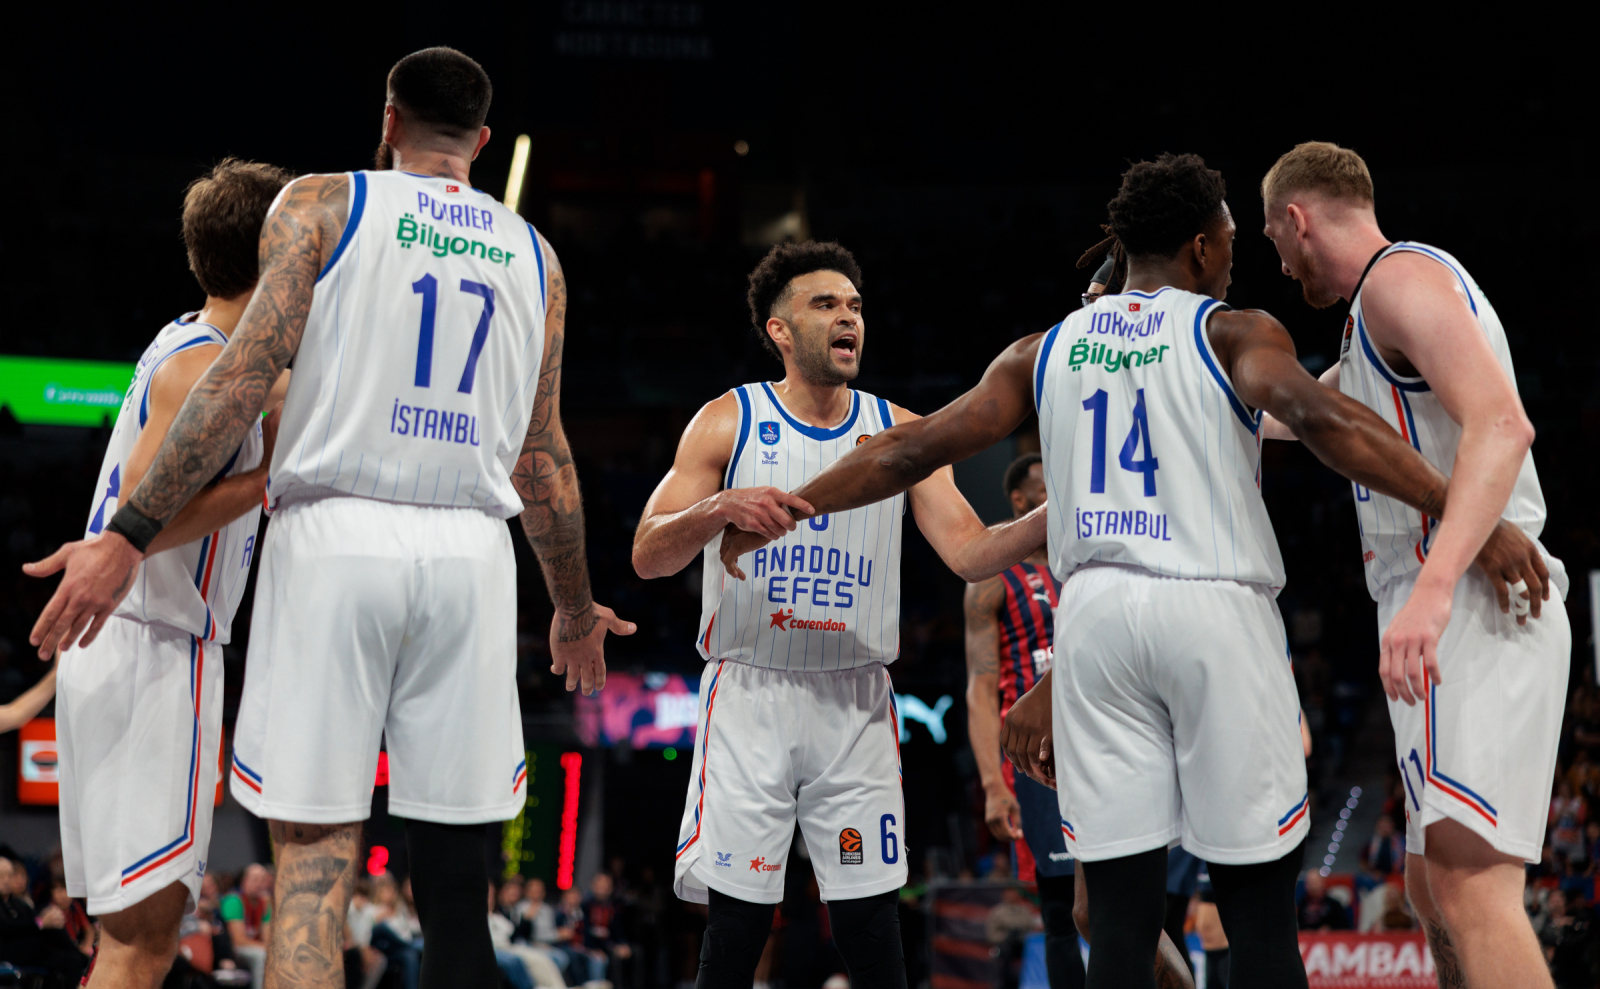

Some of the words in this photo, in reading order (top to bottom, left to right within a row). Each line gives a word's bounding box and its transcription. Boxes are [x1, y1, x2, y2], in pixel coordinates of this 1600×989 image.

[396, 212, 516, 268] Bilyoner
[412, 272, 495, 394] 17
[1081, 388, 1159, 497] 14
[1076, 507, 1171, 541] İSTANBUL
[754, 545, 872, 587] ANADOLU
[768, 576, 854, 608] EFES
[789, 617, 846, 632] corendon
[880, 813, 899, 865] 6
